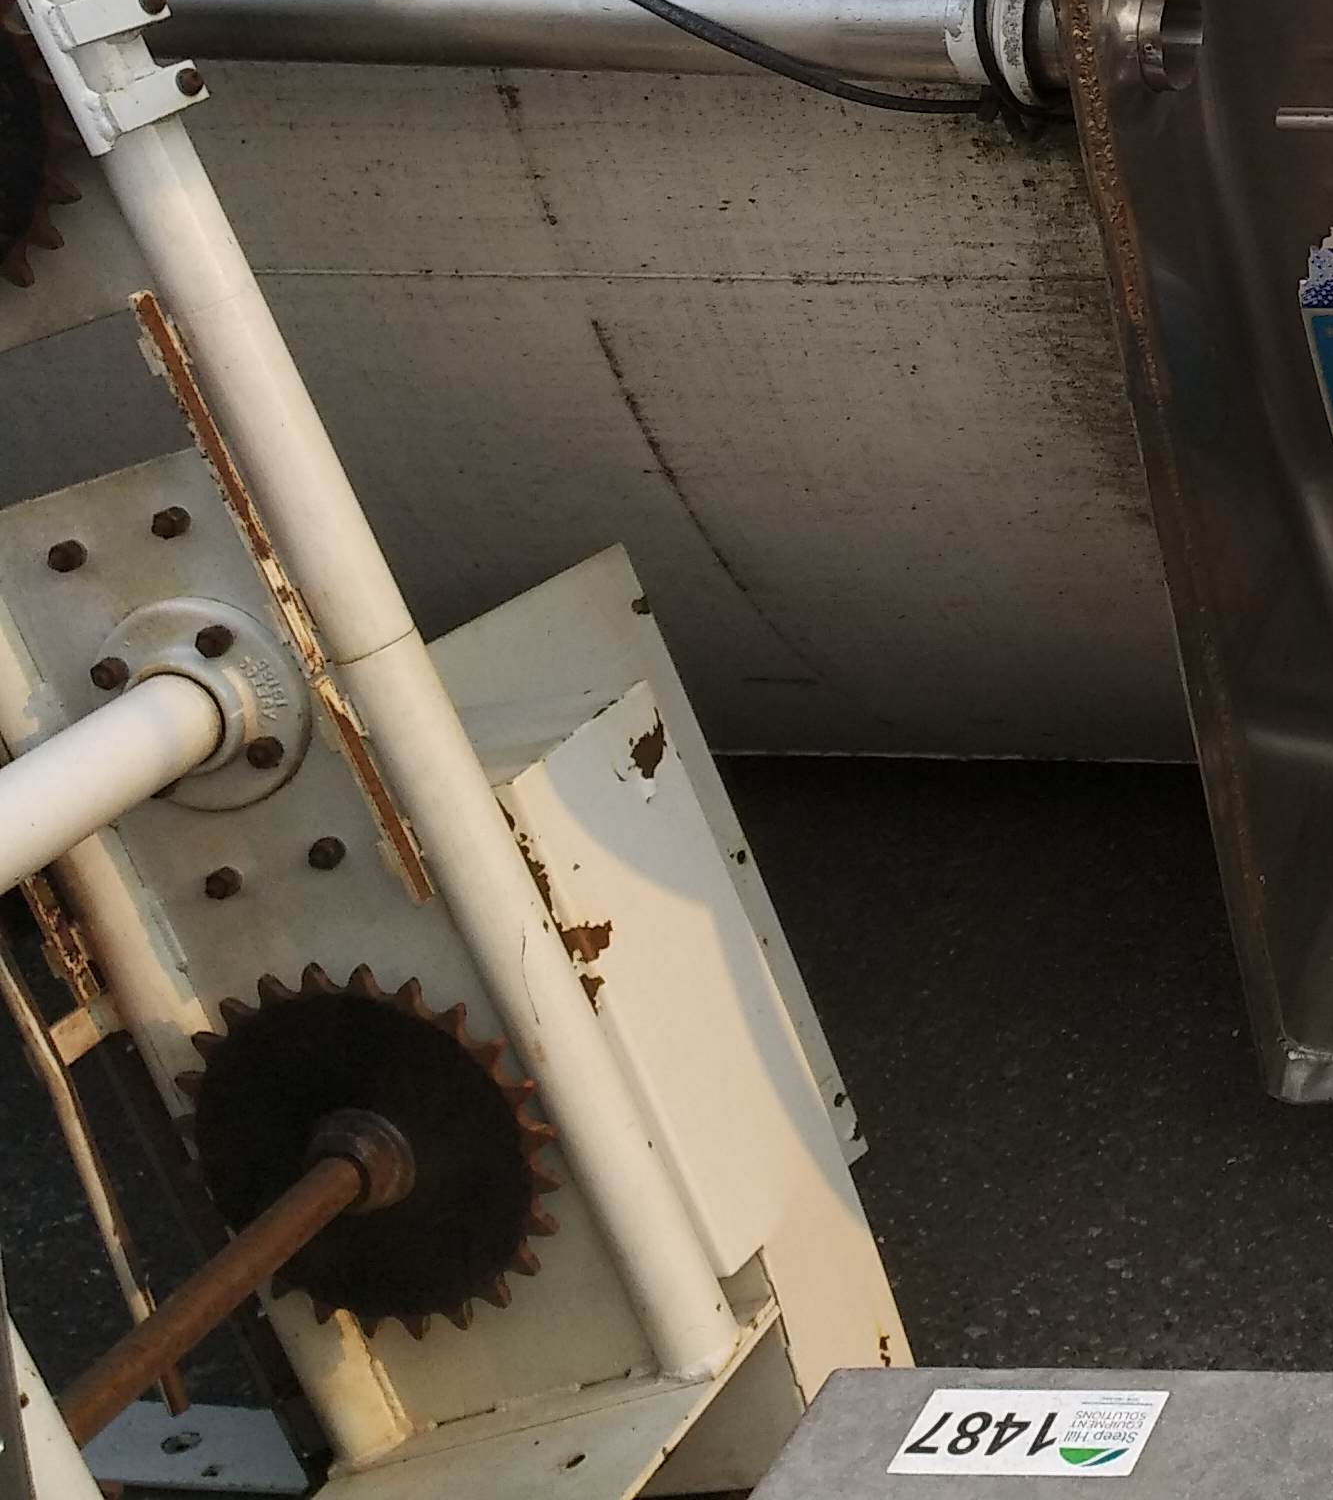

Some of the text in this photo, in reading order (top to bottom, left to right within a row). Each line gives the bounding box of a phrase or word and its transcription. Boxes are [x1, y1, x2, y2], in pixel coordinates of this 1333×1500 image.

[1075, 1410, 1147, 1420] SOLUTIONS
[1070, 1420, 1144, 1429] EQUIPMENT
[905, 1411, 1060, 1456] 1487
[1063, 1430, 1138, 1443] Steep Hill
